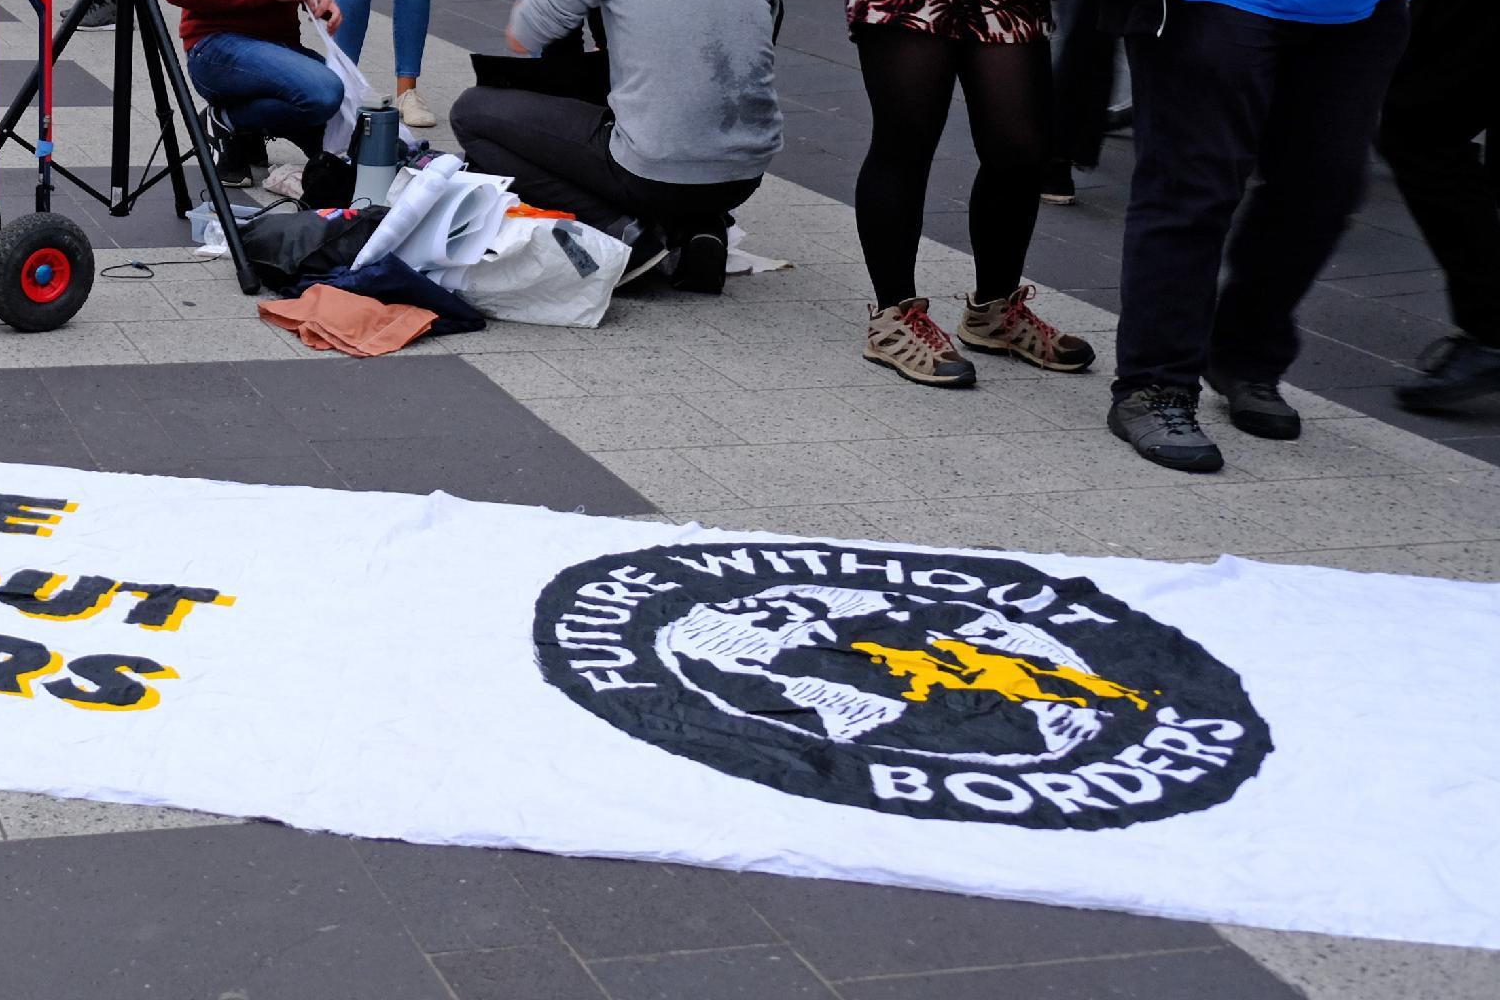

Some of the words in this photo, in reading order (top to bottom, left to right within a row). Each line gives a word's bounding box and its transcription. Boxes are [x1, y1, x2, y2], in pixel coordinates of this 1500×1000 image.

[555, 565, 683, 692] FUTURE
[670, 548, 1119, 625] WITHOUT
[868, 707, 1245, 816] BORDERS
